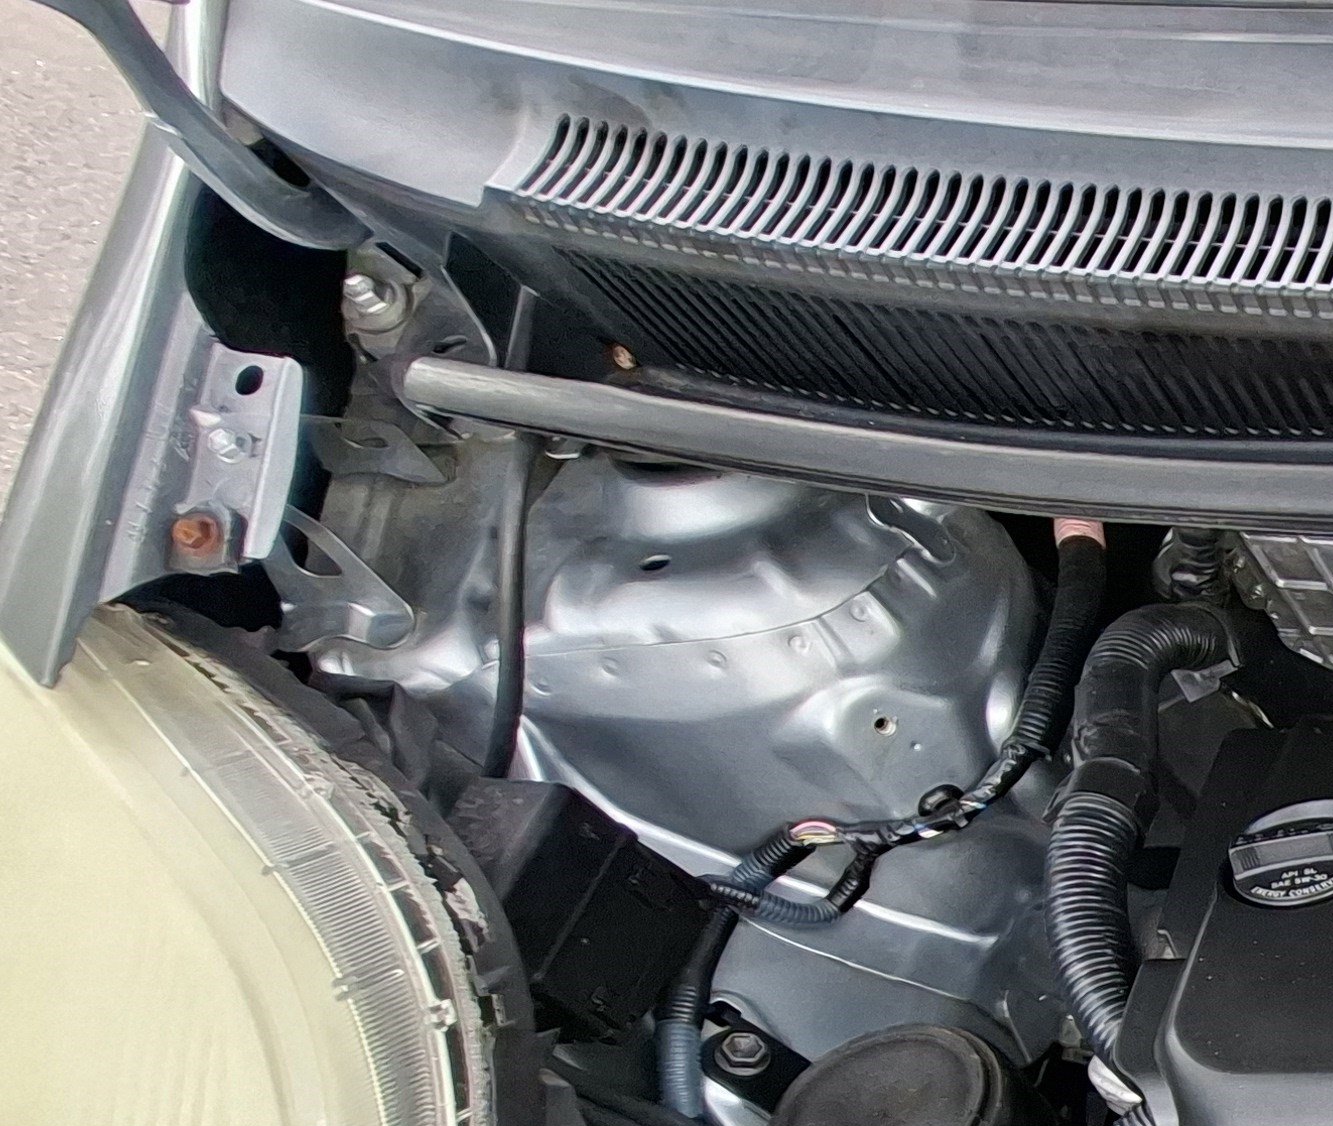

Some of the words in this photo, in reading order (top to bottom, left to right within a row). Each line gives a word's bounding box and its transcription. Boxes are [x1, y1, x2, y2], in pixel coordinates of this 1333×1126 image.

[1281, 870, 1298, 879] API
[1271, 880, 1292, 889] SAE
[1250, 886, 1287, 898] ENERGY
